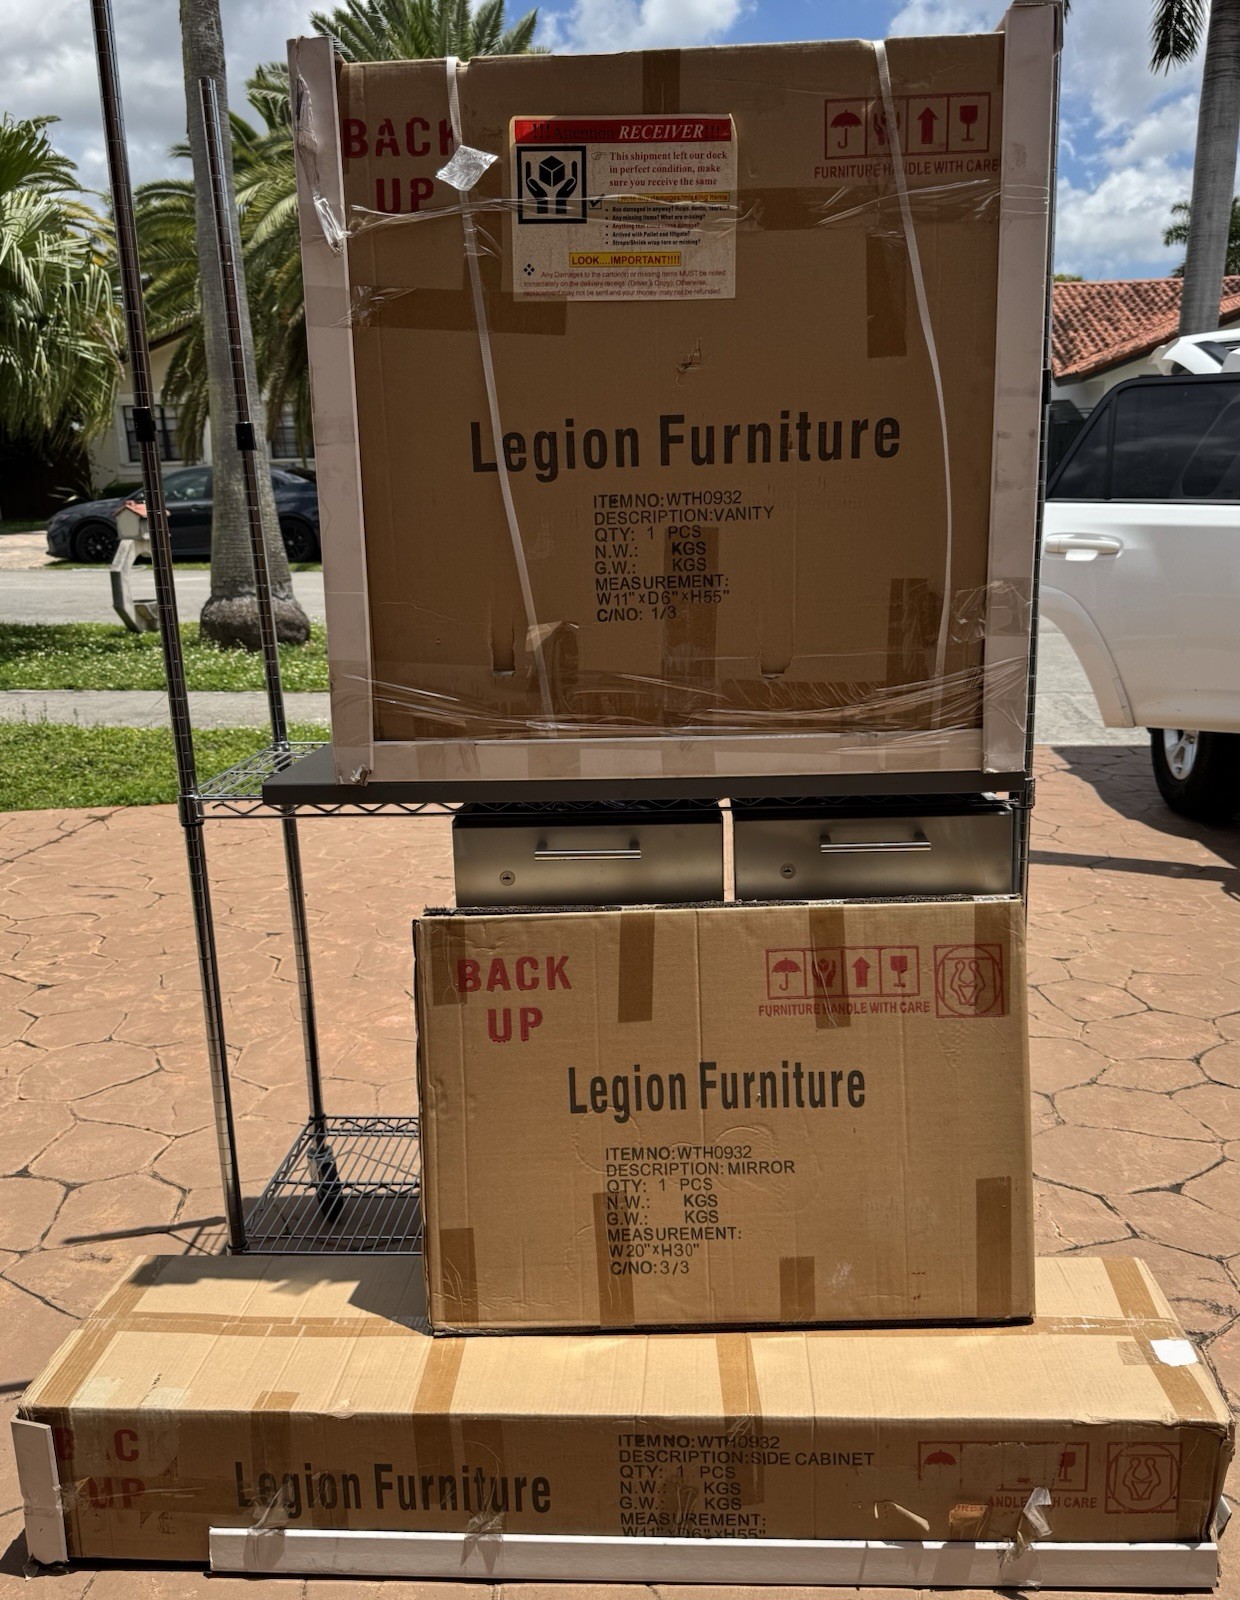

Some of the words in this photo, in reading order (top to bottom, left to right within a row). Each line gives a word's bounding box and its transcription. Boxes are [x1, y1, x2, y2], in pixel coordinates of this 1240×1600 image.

[343, 117, 456, 159] BACK
[610, 152, 629, 161] This
[631, 151, 670, 163] shipment
[673, 151, 687, 160] left
[706, 151, 728, 159] dock
[610, 165, 617, 173] in
[620, 164, 650, 175] perfect
[652, 164, 695, 173] condition,
[697, 164, 721, 172] make
[814, 164, 881, 179] FURNITURE
[934, 160, 963, 173] WITH
[966, 158, 999, 172] CARE
[609, 179, 627, 187] sure
[630, 179, 645, 188] you
[648, 178, 678, 186] receive
[680, 177, 693, 185] the
[375, 177, 434, 213] UP
[684, 213, 706, 221] missing?
[679, 238, 701, 246] missing?
[471, 418, 640, 483] Legion
[660, 410, 901, 467] Furniture
[595, 527, 635, 542] QTY:
[647, 526, 654, 540] 1
[668, 525, 702, 539] PCS
[595, 544, 638, 559] N.W.:
[671, 541, 706, 556] KGS
[595, 561, 636, 574] G.W.:
[672, 558, 707, 572] KGS
[595, 574, 730, 591] MEASUREMENT:
[597, 608, 643, 622] C/NO:
[652, 605, 677, 620] 1/3
[457, 955, 572, 993] BACK
[758, 1003, 820, 1016] FURNITURE
[822, 1002, 866, 1015] HANDLE
[869, 1002, 897, 1013] WITH
[900, 1000, 931, 1013] CARE
[487, 1007, 543, 1043] UP
[568, 1064, 688, 1123] Legion
[700, 1060, 865, 1109] Furniture
[606, 1179, 647, 1194] QTY:
[658, 1179, 666, 1192] 1
[680, 1178, 713, 1191] PCS
[607, 1195, 651, 1210] N.W.:
[684, 1194, 718, 1208] KGS
[607, 1212, 648, 1226] G.W.:
[685, 1210, 719, 1224] KGS
[607, 1227, 742, 1242] MEASUREMENT:
[795, 1451, 875, 1466] CABINET
[619, 1465, 663, 1480] QTY:
[676, 1467, 684, 1478] 1
[699, 1467, 736, 1479] PCS
[89, 1478, 146, 1510] UP
[235, 1462, 361, 1519] Legion
[374, 1463, 551, 1513] Furniture
[620, 1482, 667, 1496] N.W.:
[704, 1482, 741, 1495] KGS
[619, 1497, 664, 1511] G.W.:
[704, 1497, 742, 1510] KGS
[1065, 1497, 1097, 1508] CARE
[621, 1512, 766, 1526] MEASUREMENT:
